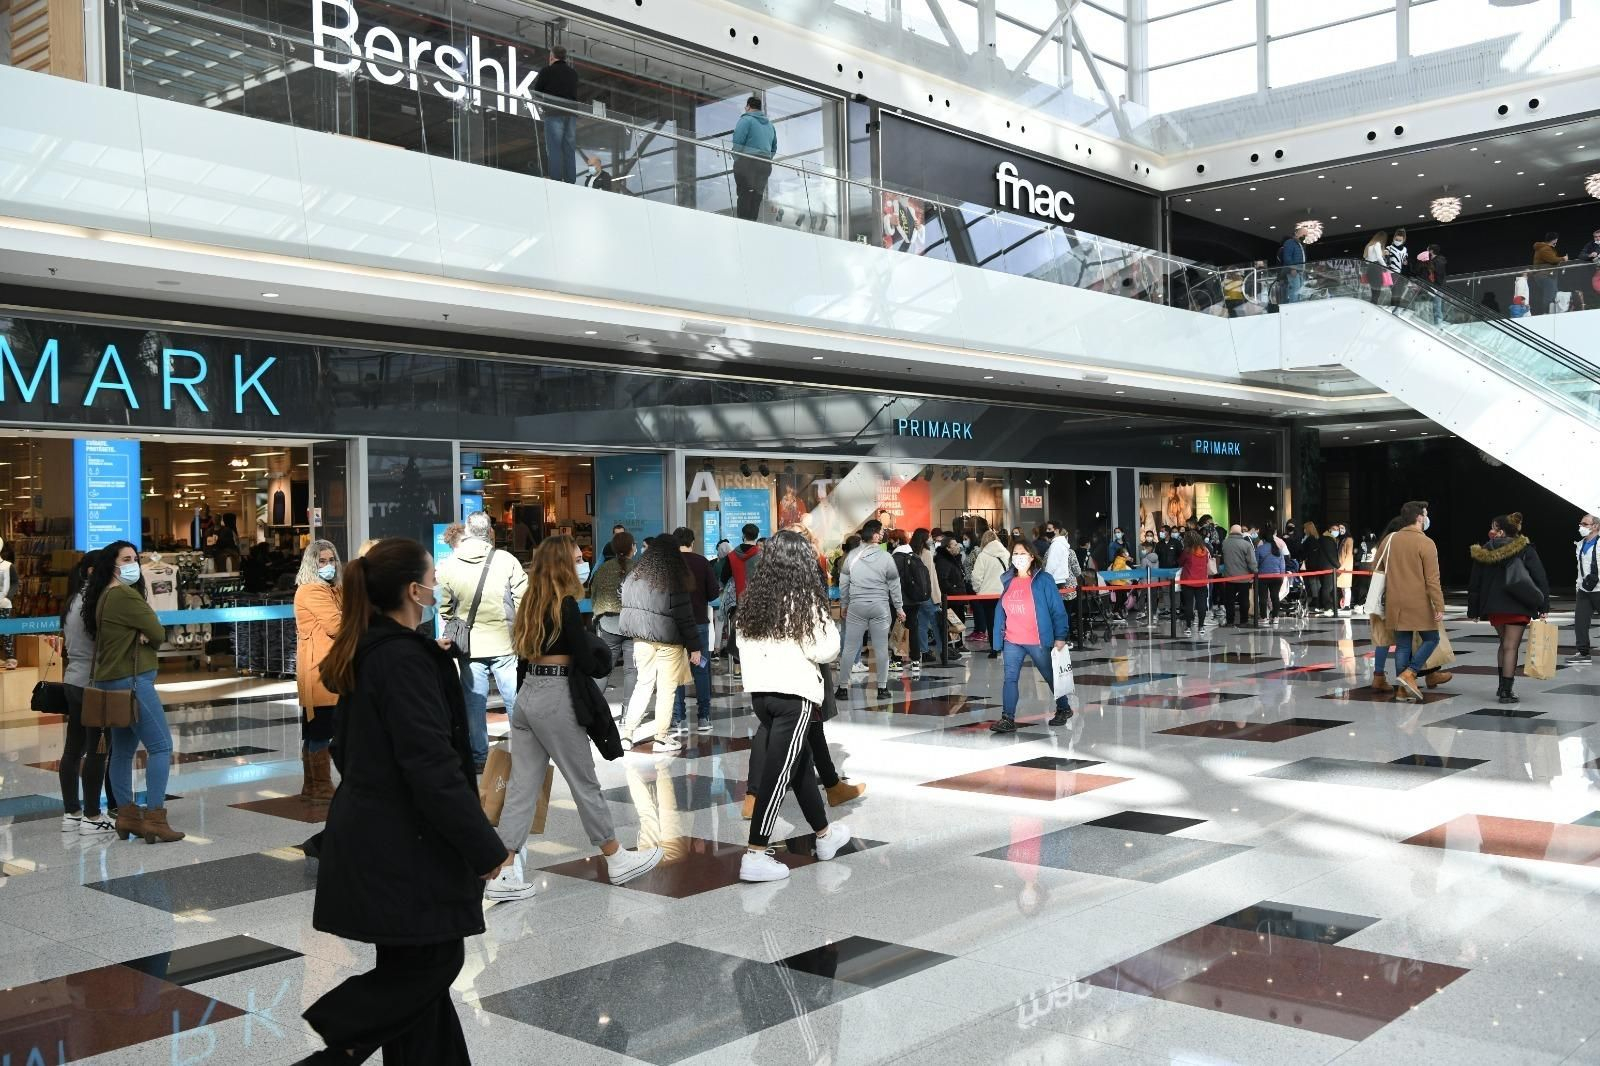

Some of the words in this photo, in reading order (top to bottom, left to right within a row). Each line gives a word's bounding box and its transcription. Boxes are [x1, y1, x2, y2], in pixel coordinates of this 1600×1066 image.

[996, 161, 1075, 223] fnac
[0, 335, 280, 416] MARK
[898, 418, 973, 440] PRIMARK
[1195, 439, 1241, 456] PRIMARK
